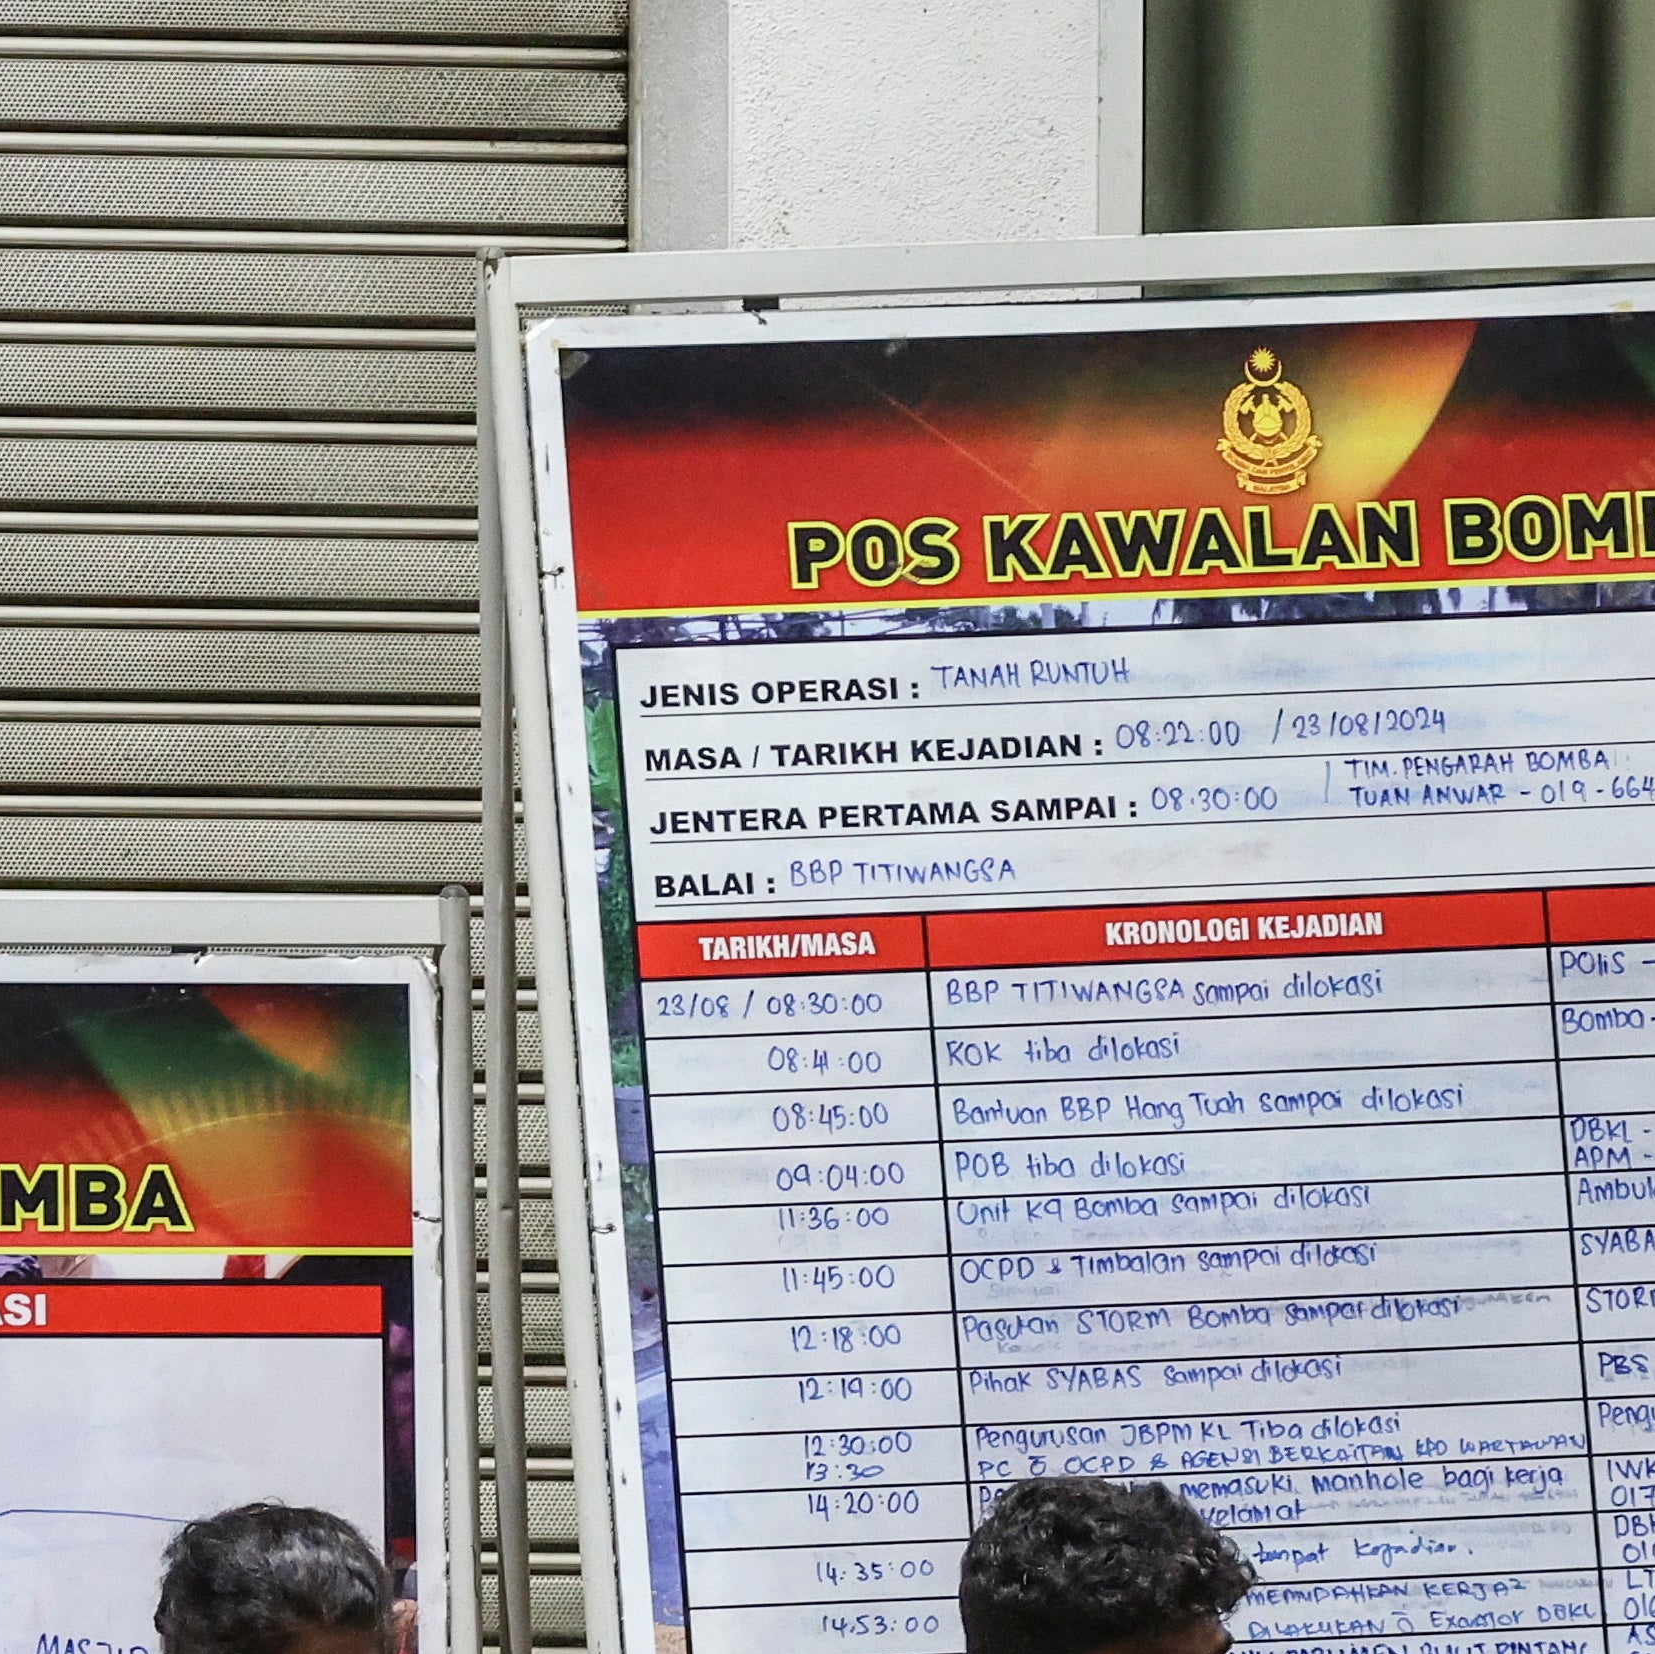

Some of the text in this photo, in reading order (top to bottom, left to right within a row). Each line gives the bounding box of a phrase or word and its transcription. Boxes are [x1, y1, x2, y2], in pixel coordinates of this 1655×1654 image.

[786, 517, 961, 590] POS
[982, 498, 1419, 583] KAWALAN
[930, 657, 1130, 689] TANAH RUNTUH
[640, 677, 898, 708] JENIS OPERASI
[1116, 720, 1240, 749] 08:22:00
[645, 734, 1082, 771] MASA TARIKH KEJADIAN
[1403, 752, 1514, 777] PENGARAH
[1348, 786, 1410, 807] TUAN
[1423, 784, 1506, 805] ANWAR
[650, 796, 1116, 835] JENTERA PERTAMA SAMPAI
[655, 872, 754, 898] BALAI
[790, 859, 842, 886] BBP
[1106, 913, 1382, 945] KRONOLOGI KEJADIAN
[699, 932, 875, 960] TARIKH/MASA
[947, 979, 998, 1005] BBP
[1193, 980, 1268, 1006] sampai
[1284, 969, 1382, 998] dilokasi
[767, 992, 882, 1017] 08:30:00
[1024, 1032, 1179, 1063] tiba dilokasi
[773, 1102, 888, 1134] 08:45:00
[953, 1083, 1463, 1130] Bantuan BBP Hang Tuah sampai dilokasi
[777, 1162, 904, 1191] 09:04:00
[1026, 1151, 1184, 1178] tiba dilokasi
[779, 1207, 889, 1231] 11:36:00
[957, 1201, 1010, 1225] Unit
[1075, 1192, 1159, 1220] Bomba
[1172, 1192, 1257, 1215] sampai
[1273, 1185, 1370, 1209] dilokasi
[961, 1257, 1034, 1283] OCPD
[1198, 1246, 1280, 1271] sampai
[1291, 1242, 1376, 1267] dilokasi
[783, 1264, 894, 1294] 11:45:00
[1189, 1295, 1461, 1329] Bomba dilokasi
[799, 1377, 912, 1403] 12:19:00
[969, 1357, 1341, 1392] Pihak SYABAS sampai dilokasi
[803, 1431, 912, 1459] 12:30:00
[976, 1426, 1106, 1454] Pengurusan
[1201, 1422, 1231, 1442] KL
[1240, 1420, 1302, 1441] Tiba
[1311, 1411, 1400, 1439] dilokasi
[1312, 1465, 1563, 1495] manhole bagi kerja
